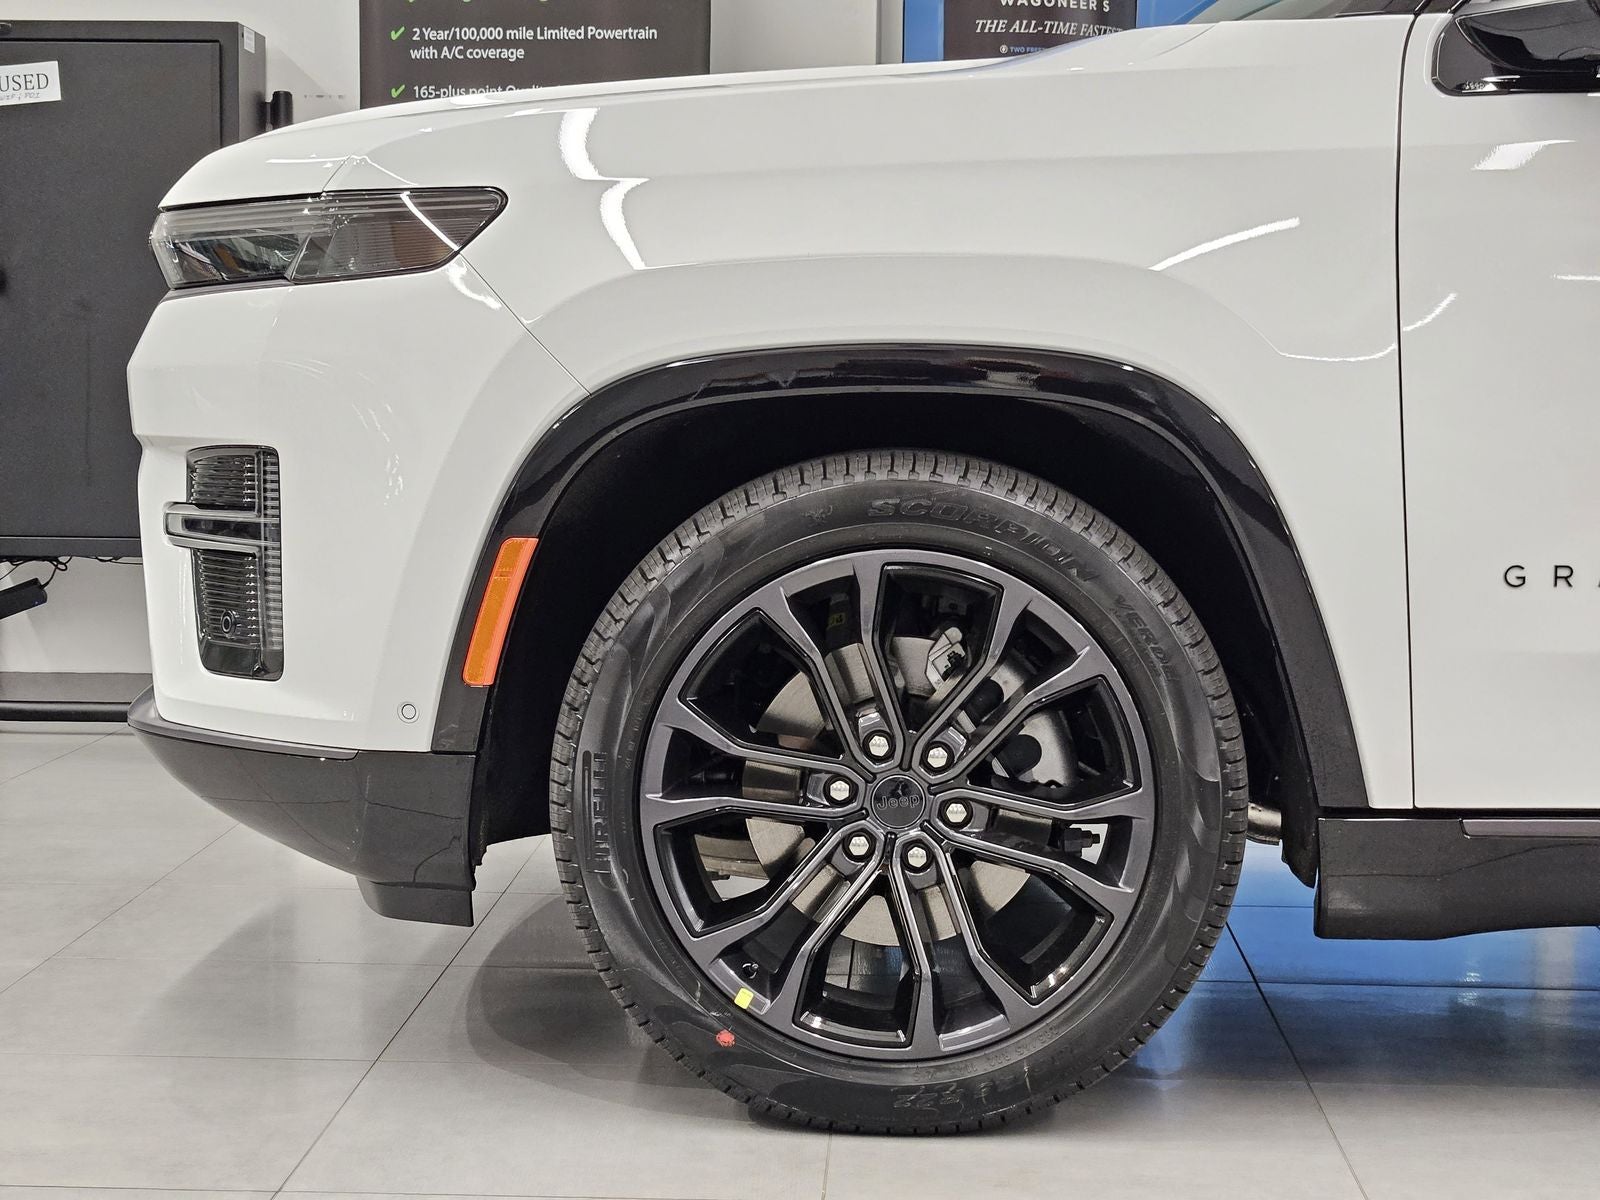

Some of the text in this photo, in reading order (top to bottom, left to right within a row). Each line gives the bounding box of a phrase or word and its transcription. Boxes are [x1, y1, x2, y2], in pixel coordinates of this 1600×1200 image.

[412, 25, 658, 41] 2 Year/100,000 mile Limited Powertrain
[975, 19, 1123, 37] THE ALL-TIME FASTE
[410, 46, 525, 62] with A/C coverage
[413, 85, 466, 98] 165-plus
[866, 498, 1100, 583] SCORPION
[1503, 564, 1600, 588] GR
[876, 794, 920, 810] Jeep
